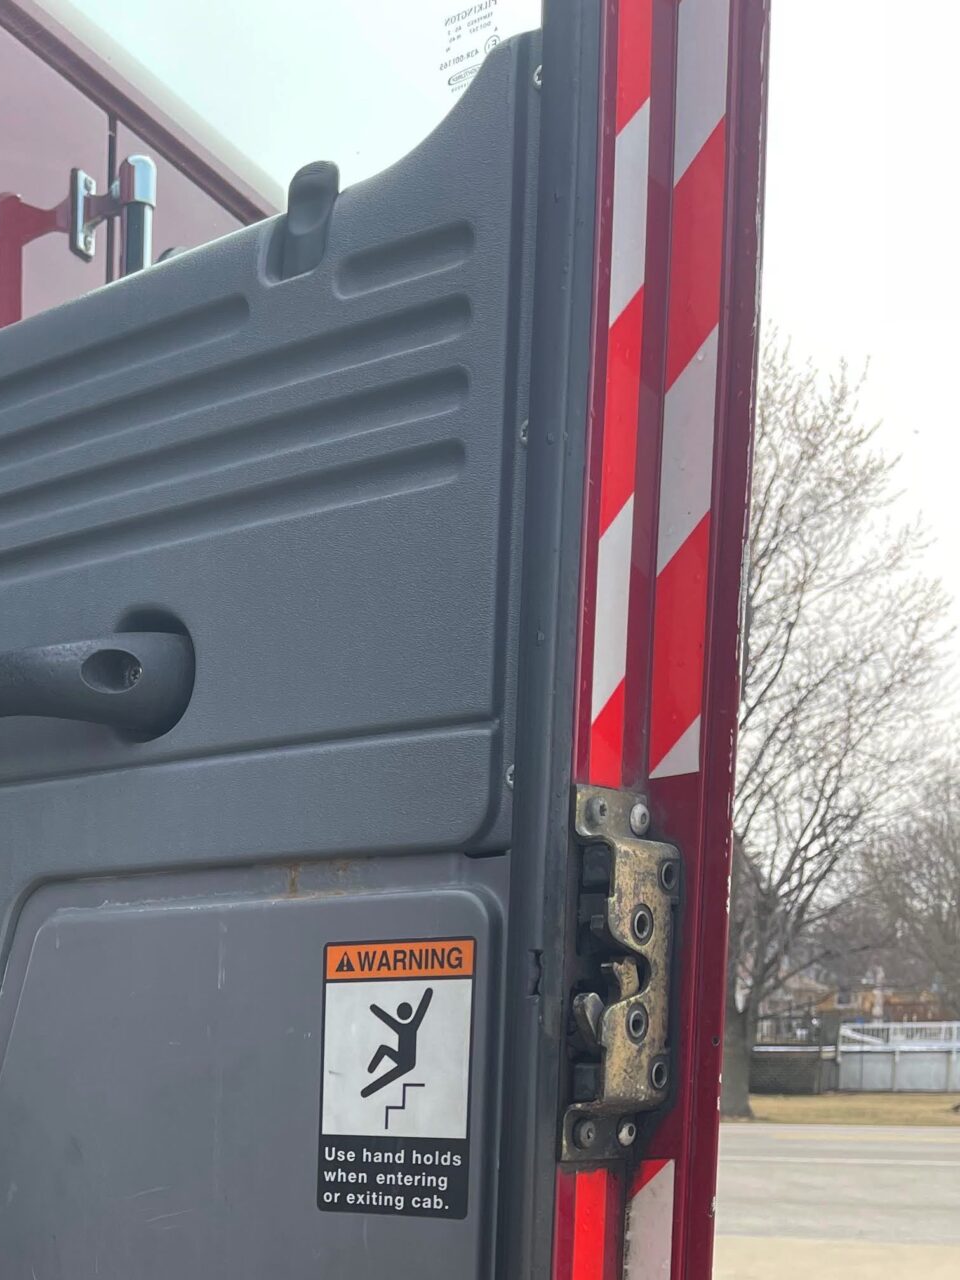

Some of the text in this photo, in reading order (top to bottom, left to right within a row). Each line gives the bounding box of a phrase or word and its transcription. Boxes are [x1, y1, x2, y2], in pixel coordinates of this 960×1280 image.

[357, 946, 463, 972] WARNING
[325, 1146, 462, 1166] Use hand holds
[323, 1169, 448, 1191] when entering
[323, 1191, 449, 1210] or exiting cab.
